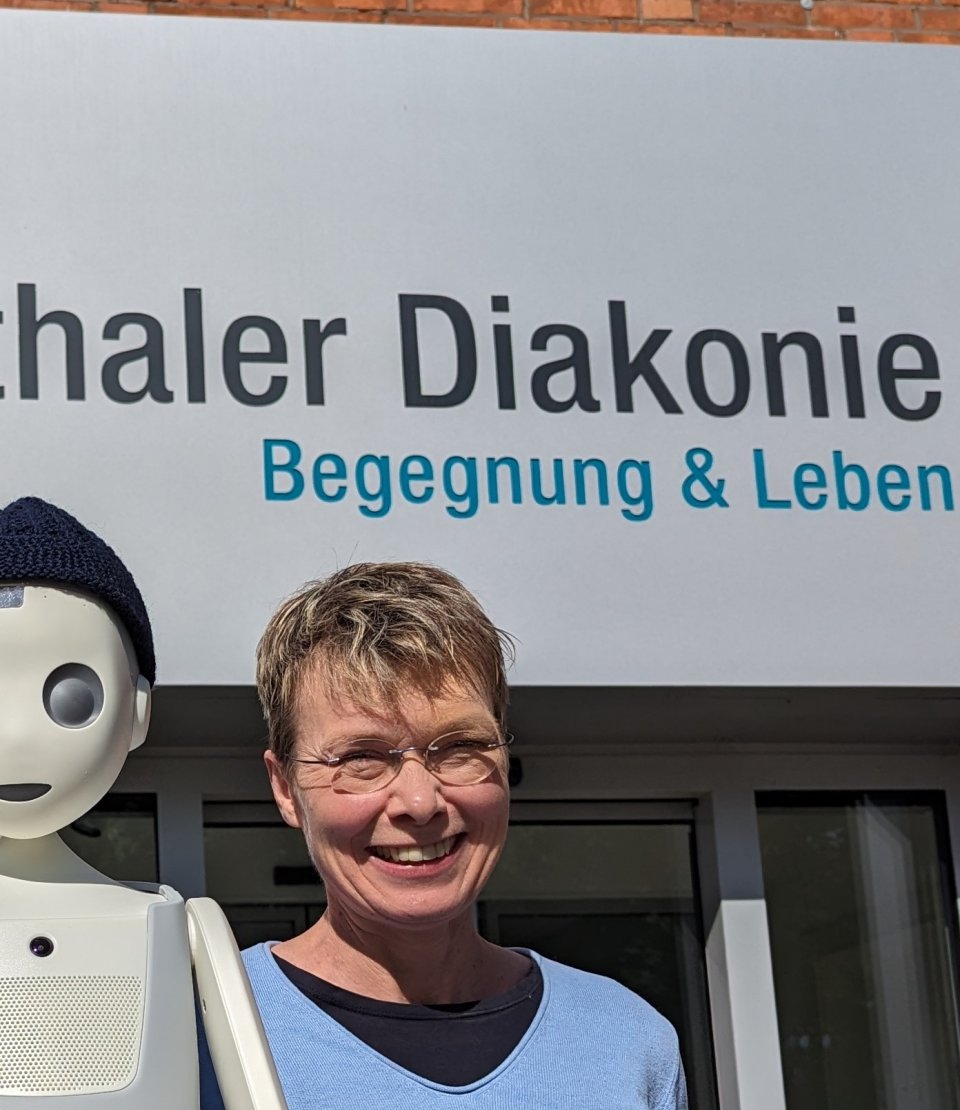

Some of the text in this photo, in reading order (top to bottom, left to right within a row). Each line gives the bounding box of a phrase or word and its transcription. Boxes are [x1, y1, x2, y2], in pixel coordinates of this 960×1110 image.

[397, 292, 943, 421] Diakonie
[262, 438, 955, 522] Begegnung & Leben
